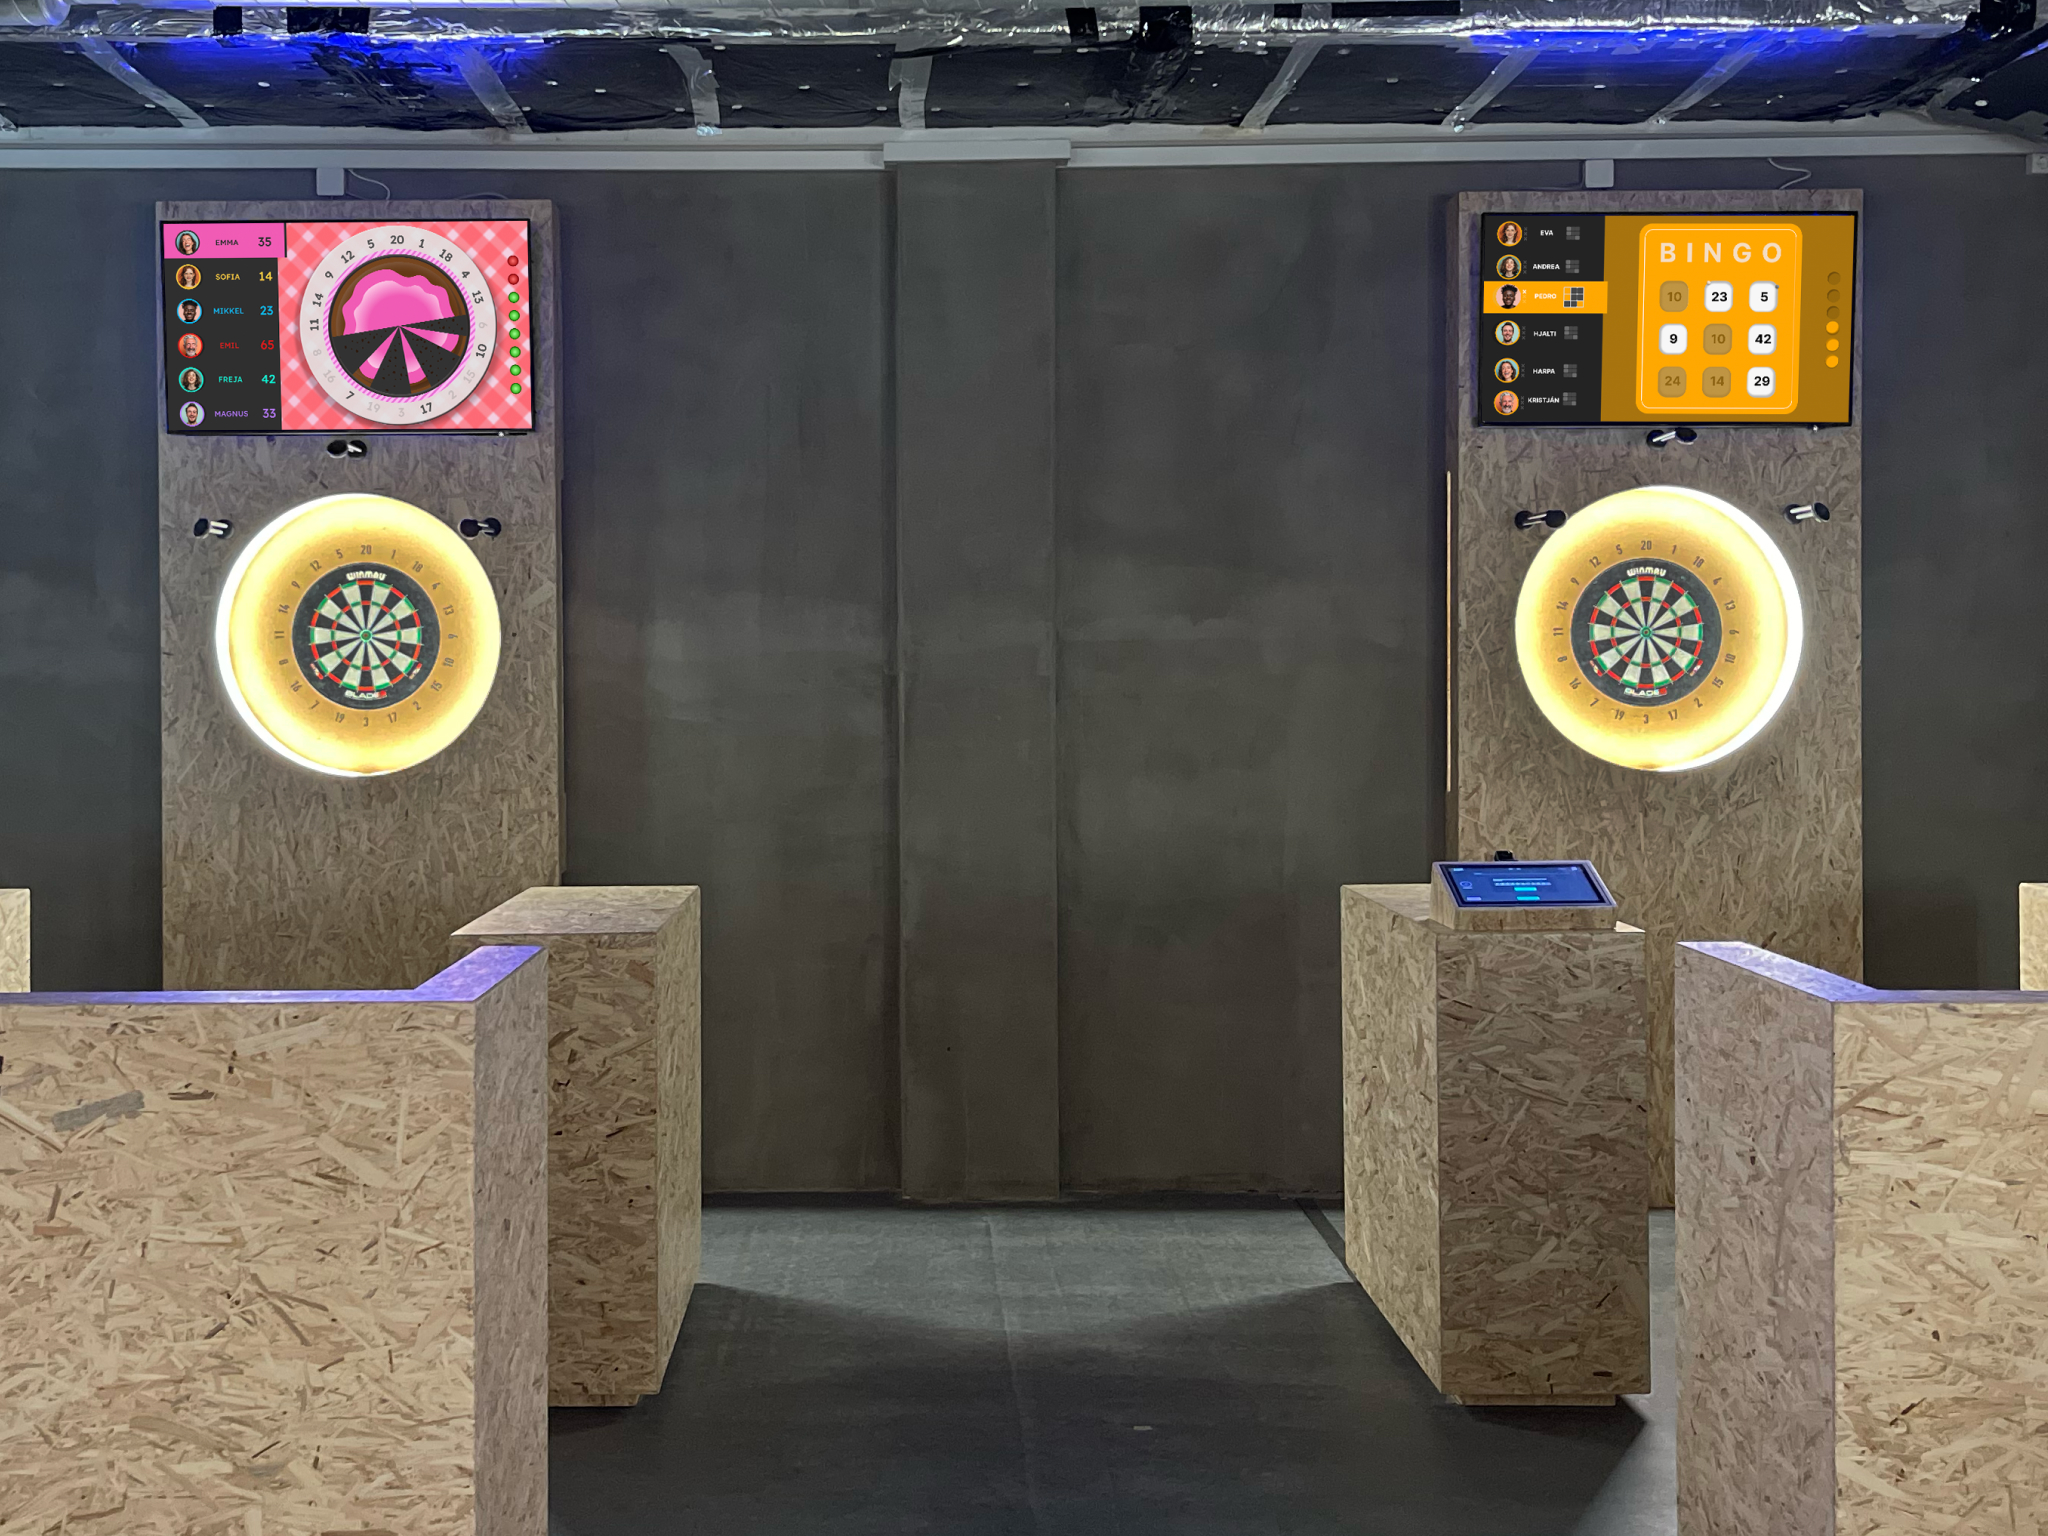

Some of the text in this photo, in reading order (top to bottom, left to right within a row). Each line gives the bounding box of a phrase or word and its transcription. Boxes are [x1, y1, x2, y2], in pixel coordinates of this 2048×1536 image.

[257, 237, 272, 247] 35
[367, 239, 375, 249] 5
[390, 235, 404, 245] 20
[418, 239, 425, 248] 1
[340, 250, 355, 264] 12
[438, 249, 454, 262] 18
[1660, 242, 1782, 263] BINGO
[259, 271, 273, 281] 14
[325, 271, 334, 279] 9
[461, 270, 470, 278] 4
[312, 292, 324, 307] 14
[471, 290, 484, 304] 13
[1667, 292, 1682, 302] 10
[1711, 292, 1728, 302] 23
[1761, 292, 1769, 302] 5
[213, 306, 274, 316] MIKKEL 23
[309, 318, 320, 331] 11
[1670, 334, 1678, 344] 9
[1711, 334, 1726, 344] 10
[1755, 334, 1772, 344] 42
[260, 340, 275, 350] 65
[476, 343, 487, 358] 10
[261, 374, 276, 384] 42
[323, 369, 336, 383] 16
[463, 369, 476, 383] 15
[1665, 376, 1681, 386] 24
[1710, 376, 1724, 386] 14
[1754, 376, 1770, 386] 29
[346, 391, 355, 400] 7
[448, 390, 457, 399] 2
[367, 401, 380, 413] 19
[398, 407, 405, 417] 3
[420, 402, 433, 415] 17
[262, 408, 277, 419] 33
[360, 545, 372, 555] 20
[1616, 545, 1623, 554] 5
[1641, 540, 1652, 550] 20
[1672, 545, 1677, 554] 1
[336, 549, 343, 559] 5
[391, 549, 396, 559] 1
[310, 560, 322, 571] 12
[412, 561, 424, 572] 18
[1589, 556, 1601, 568] 12
[291, 581, 301, 589] 9
[278, 604, 290, 614] 14
[1556, 601, 1569, 610] 14
[1724, 600, 1736, 610] 13
[443, 605, 454, 616] 13
[274, 630, 285, 639] 11
[1553, 627, 1564, 636] 11
[443, 657, 455, 667] 10
[1725, 653, 1736, 664] 10
[291, 681, 302, 692] 16
[431, 681, 442, 691] 15
[1569, 678, 1581, 689] 16
[1712, 677, 1724, 688] 15
[413, 701, 421, 711] 2
[1694, 698, 1703, 707] 2
[335, 712, 345, 723] 19
[388, 712, 397, 723] 17
[1615, 709, 1624, 720] 19
[1643, 714, 1649, 724] 3
[1668, 709, 1678, 720] 17
[363, 717, 369, 727] 3
